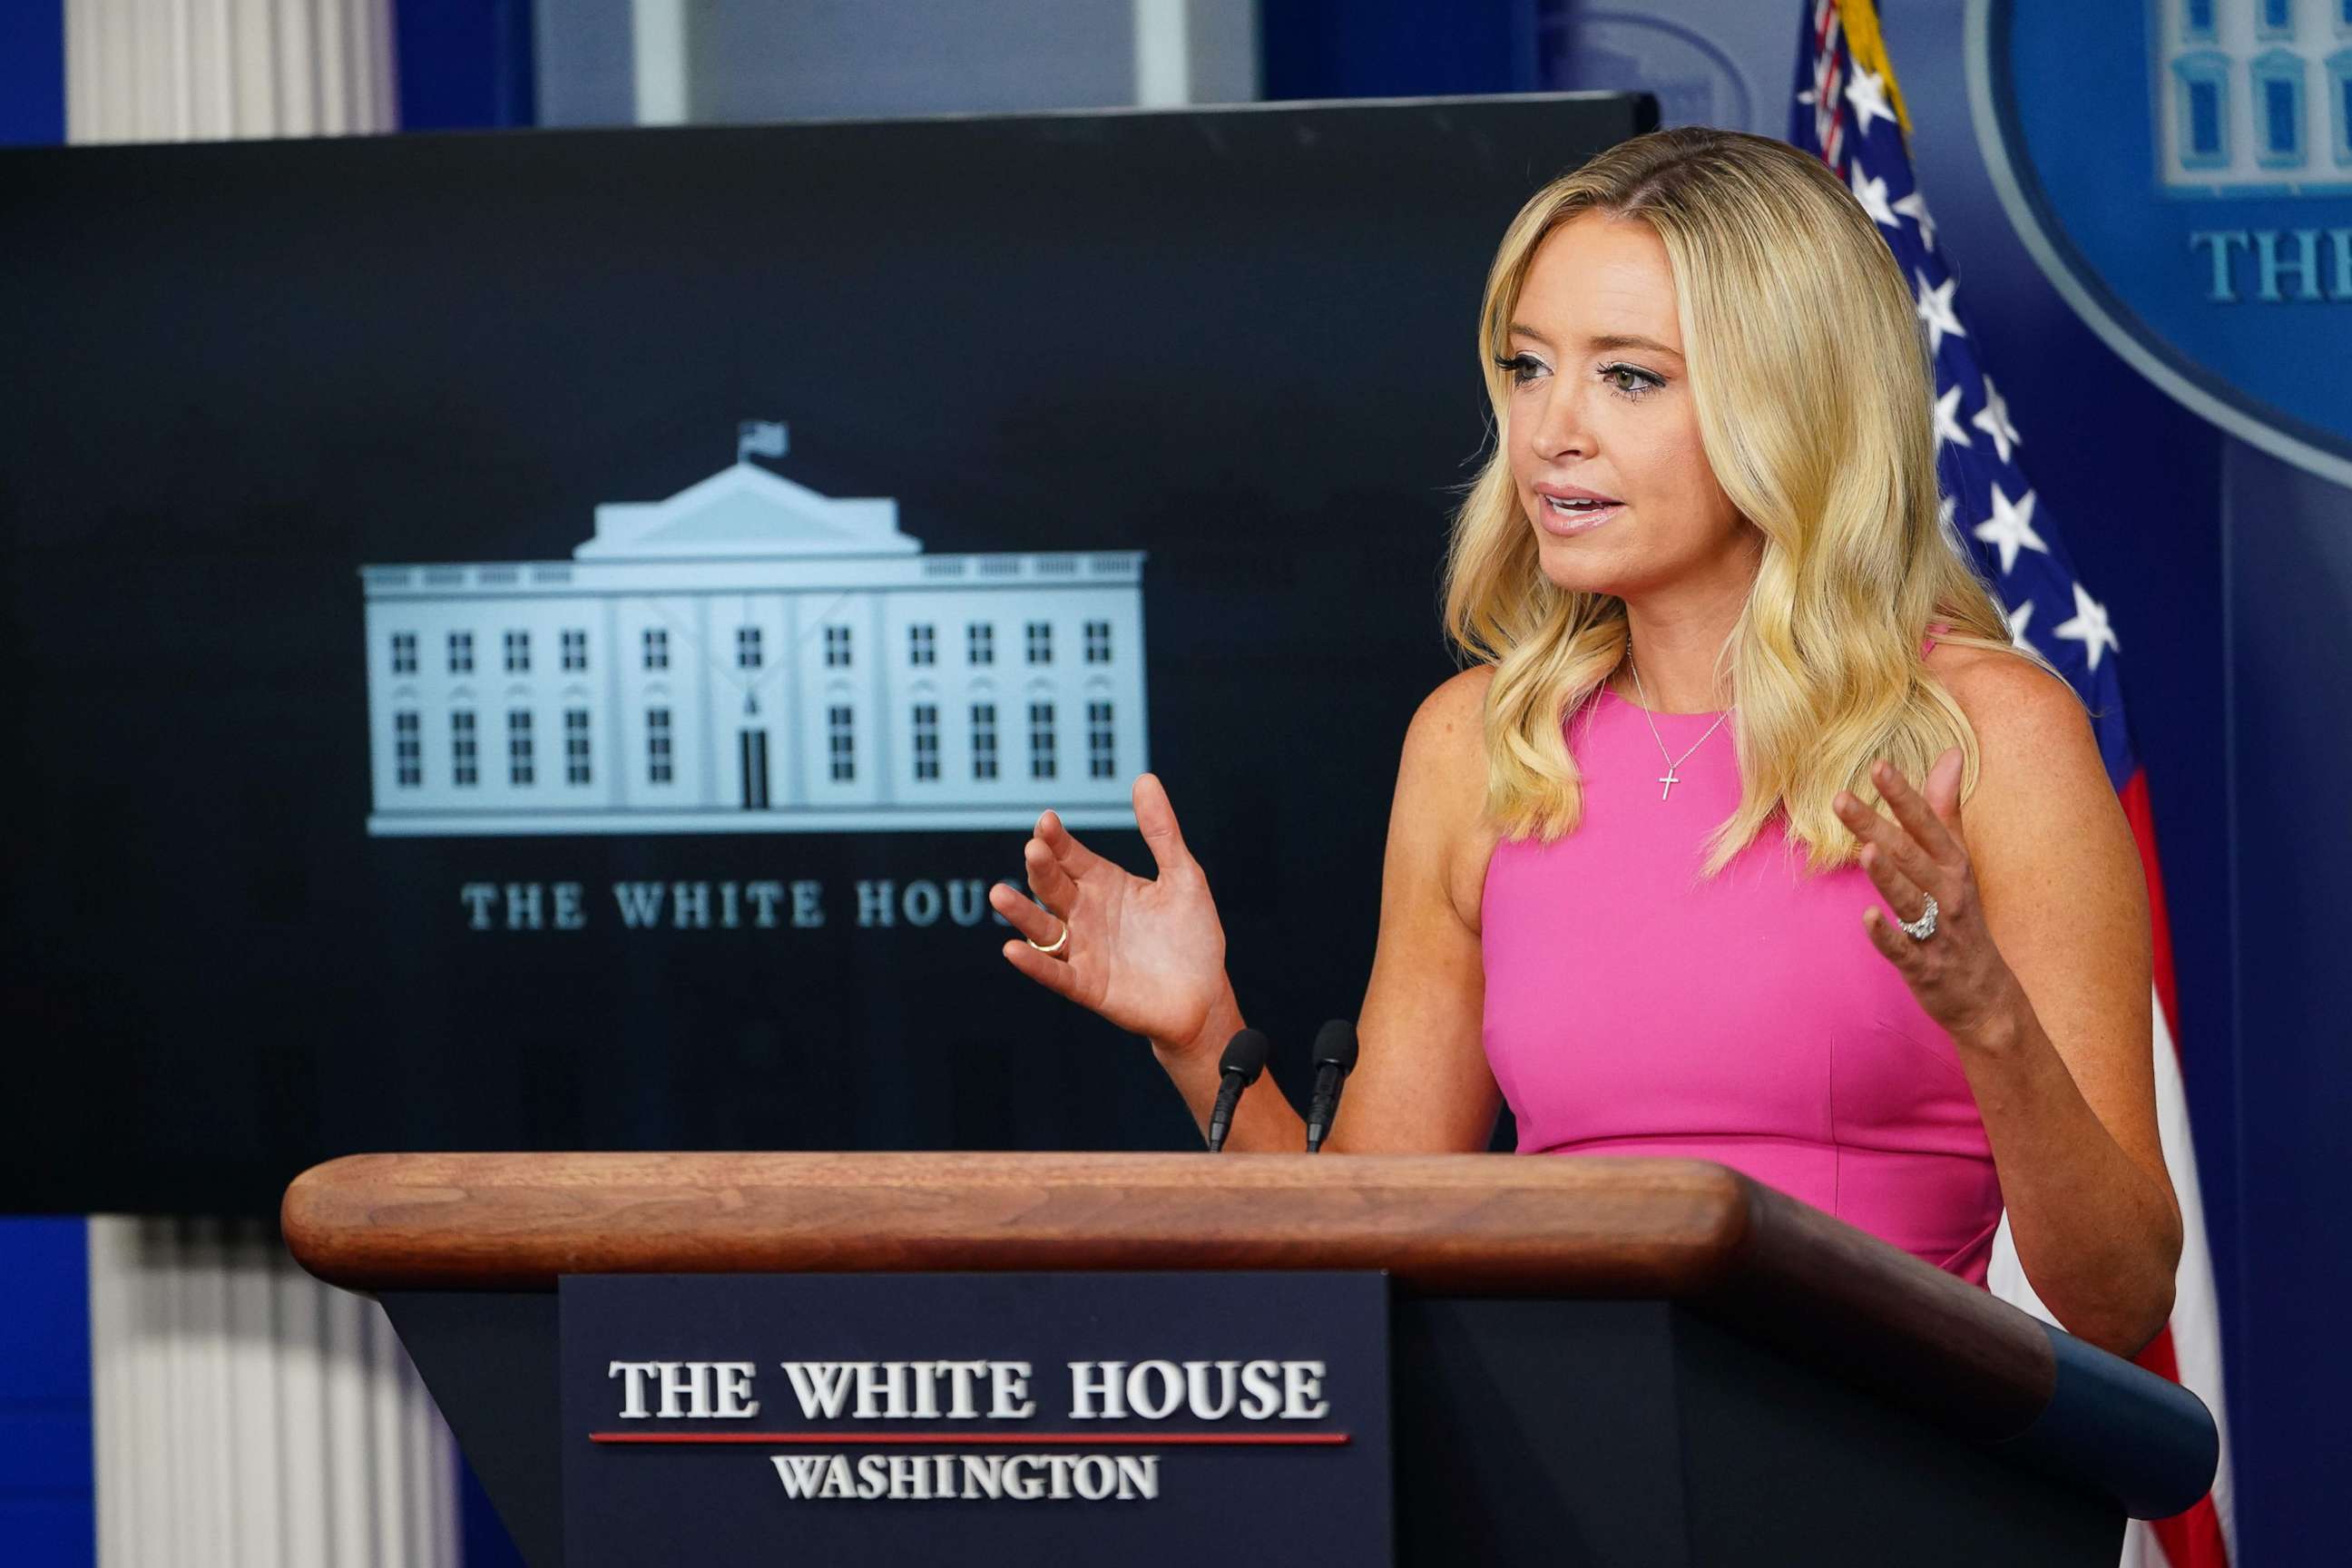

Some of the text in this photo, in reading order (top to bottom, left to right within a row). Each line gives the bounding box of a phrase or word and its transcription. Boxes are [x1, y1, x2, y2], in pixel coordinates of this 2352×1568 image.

[461, 881, 585, 930] THE
[612, 880, 825, 929] WHITE
[609, 1359, 1329, 1420] THE WHITE HOUSE
[769, 1454, 1161, 1500] WASHINGTON
